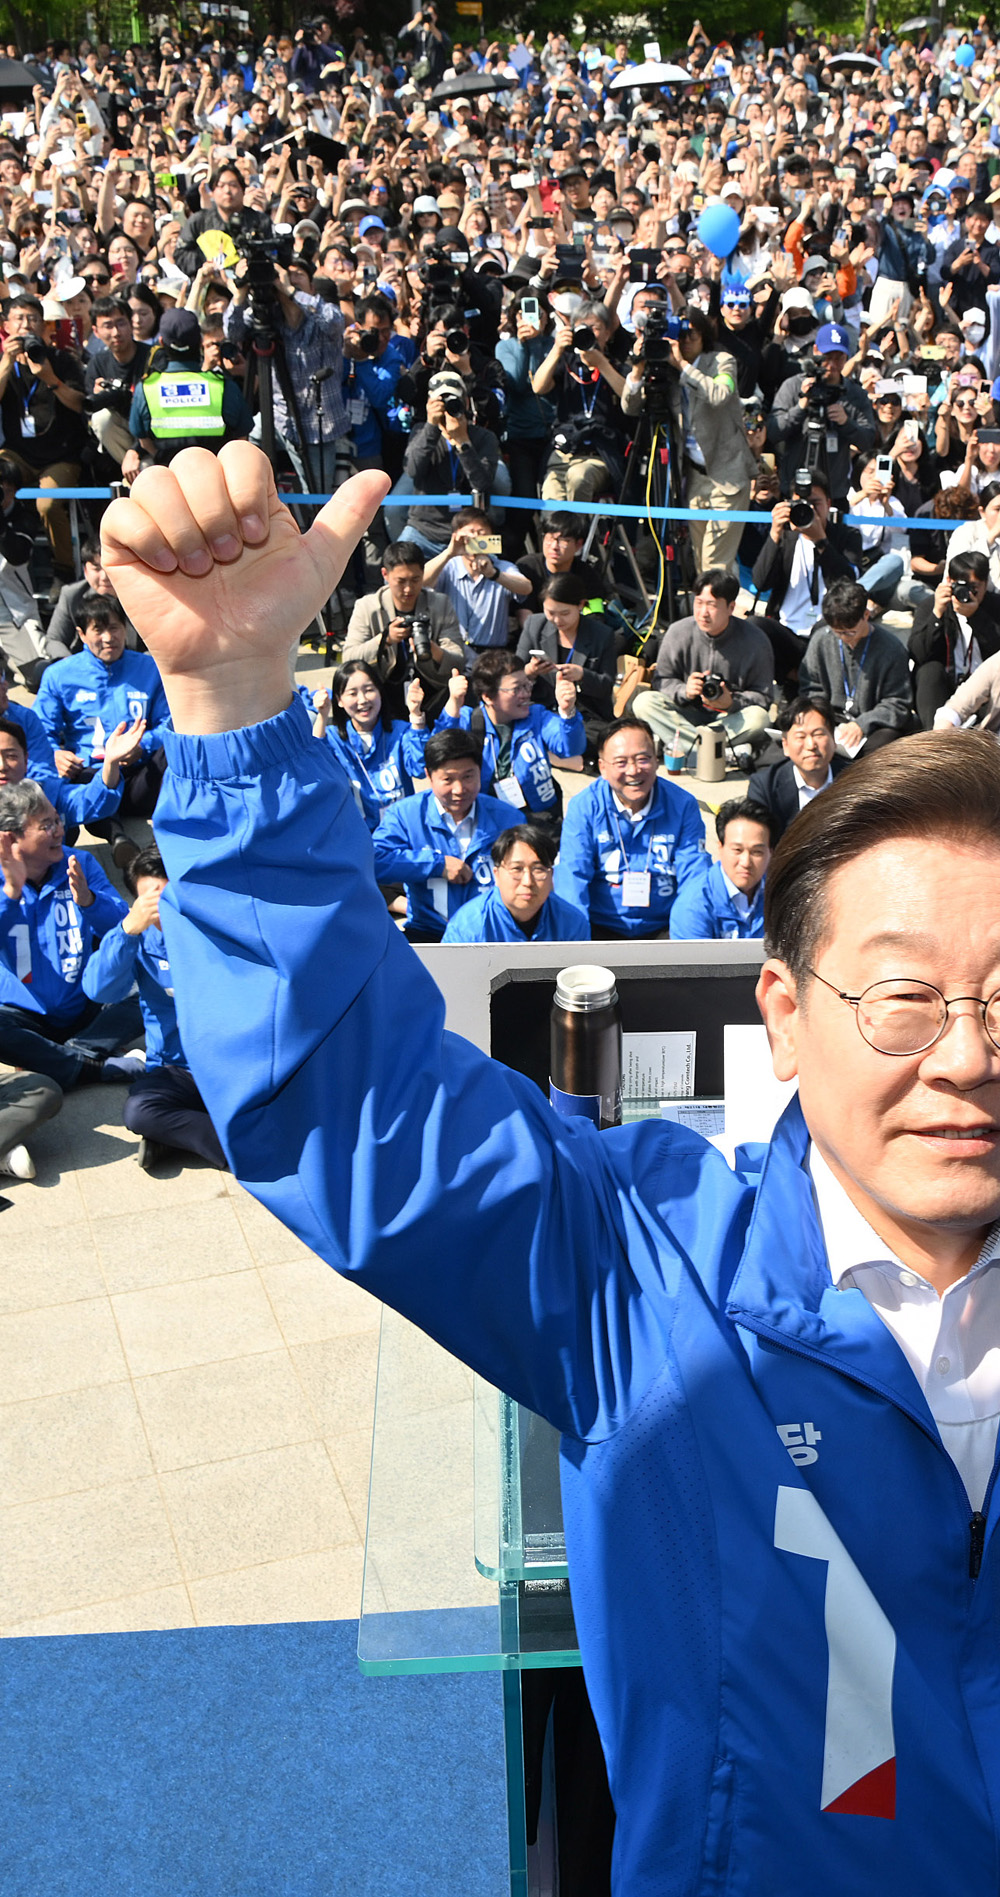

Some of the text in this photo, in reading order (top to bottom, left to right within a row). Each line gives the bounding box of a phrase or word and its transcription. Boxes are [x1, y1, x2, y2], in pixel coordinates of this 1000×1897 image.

[520, 738, 556, 803] 이재명
[8, 923, 33, 983] 1
[54, 900, 84, 984] 이재명
[773, 1485, 897, 1821] 1
